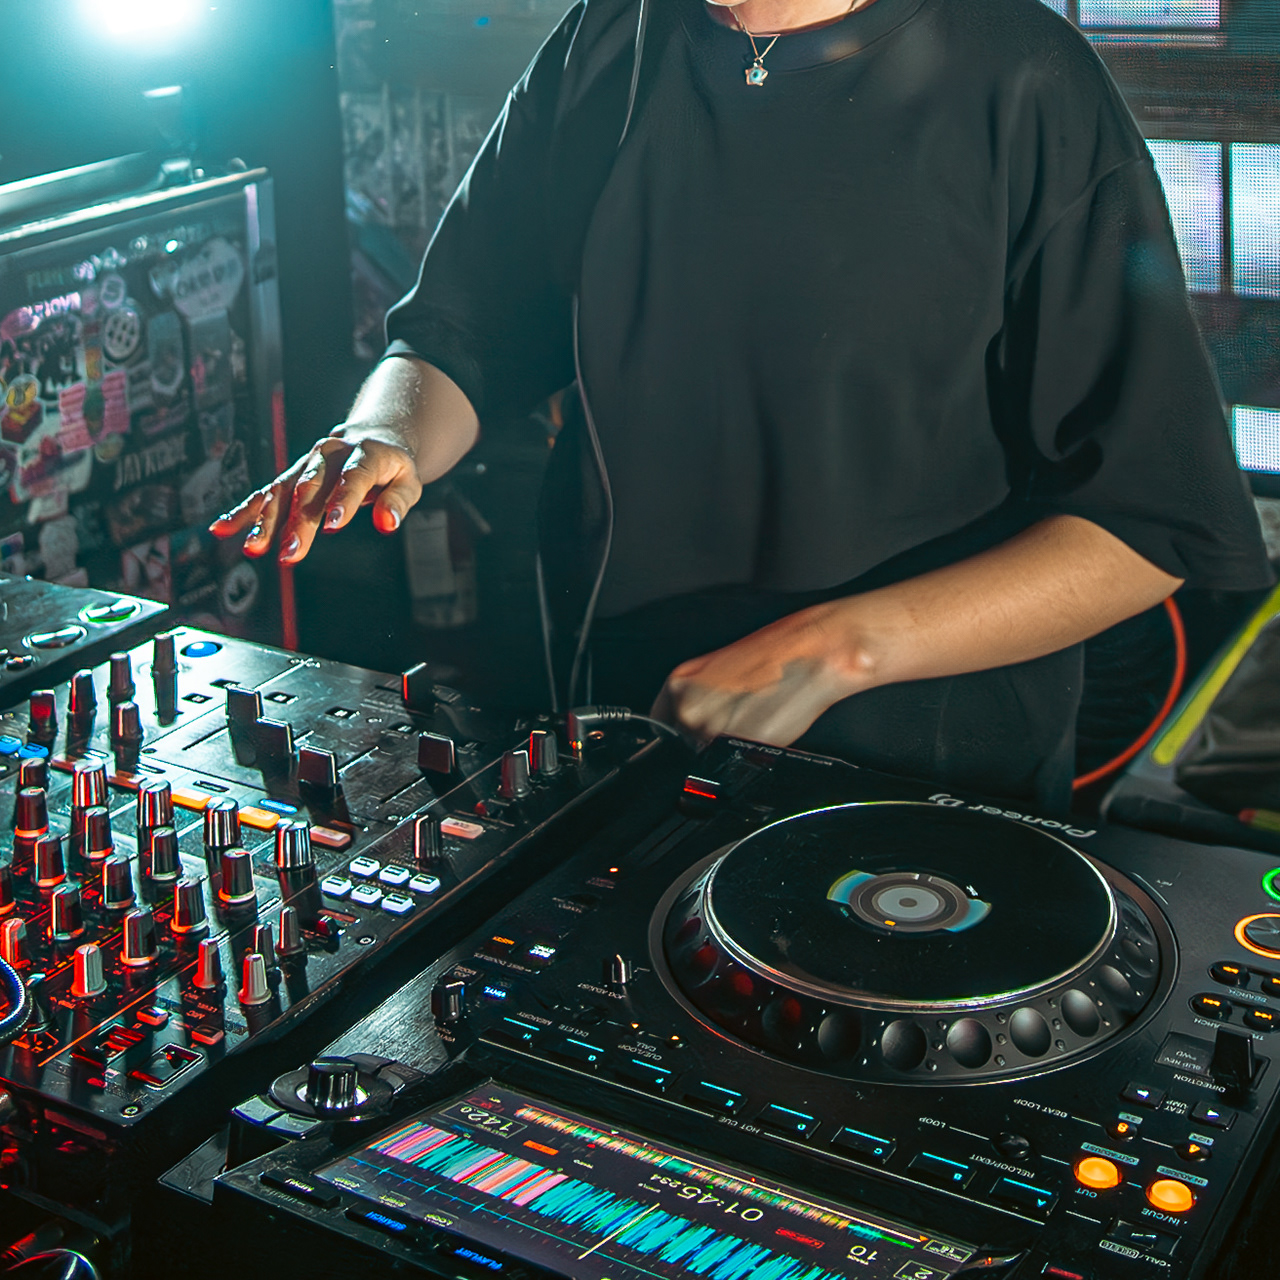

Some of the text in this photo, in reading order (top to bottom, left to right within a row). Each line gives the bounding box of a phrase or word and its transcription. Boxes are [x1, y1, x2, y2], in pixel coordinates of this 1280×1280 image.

[928, 793, 1097, 838] Pioneer DJ
[483, 986, 507, 1000] VINYL
[558, 1023, 590, 1038] DELETE
[1174, 1073, 1226, 1093] DIRECTION
[1013, 1098, 1068, 1118] BEAT LOOP
[718, 1116, 761, 1135] HOT CUE
[918, 1116, 946, 1129] LOOP
[874, 1147, 883, 1155] C
[969, 1153, 1035, 1179] RELOOP/EXIT
[284, 1178, 314, 1192] MENU
[1075, 1187, 1098, 1198] OUT
[1037, 1198, 1047, 1208] A
[364, 1211, 407, 1232] SEARCH
[1141, 1207, 1180, 1226] IN/CUE
[454, 1247, 502, 1271] PLAYLIST
[849, 1245, 879, 1263] 10
